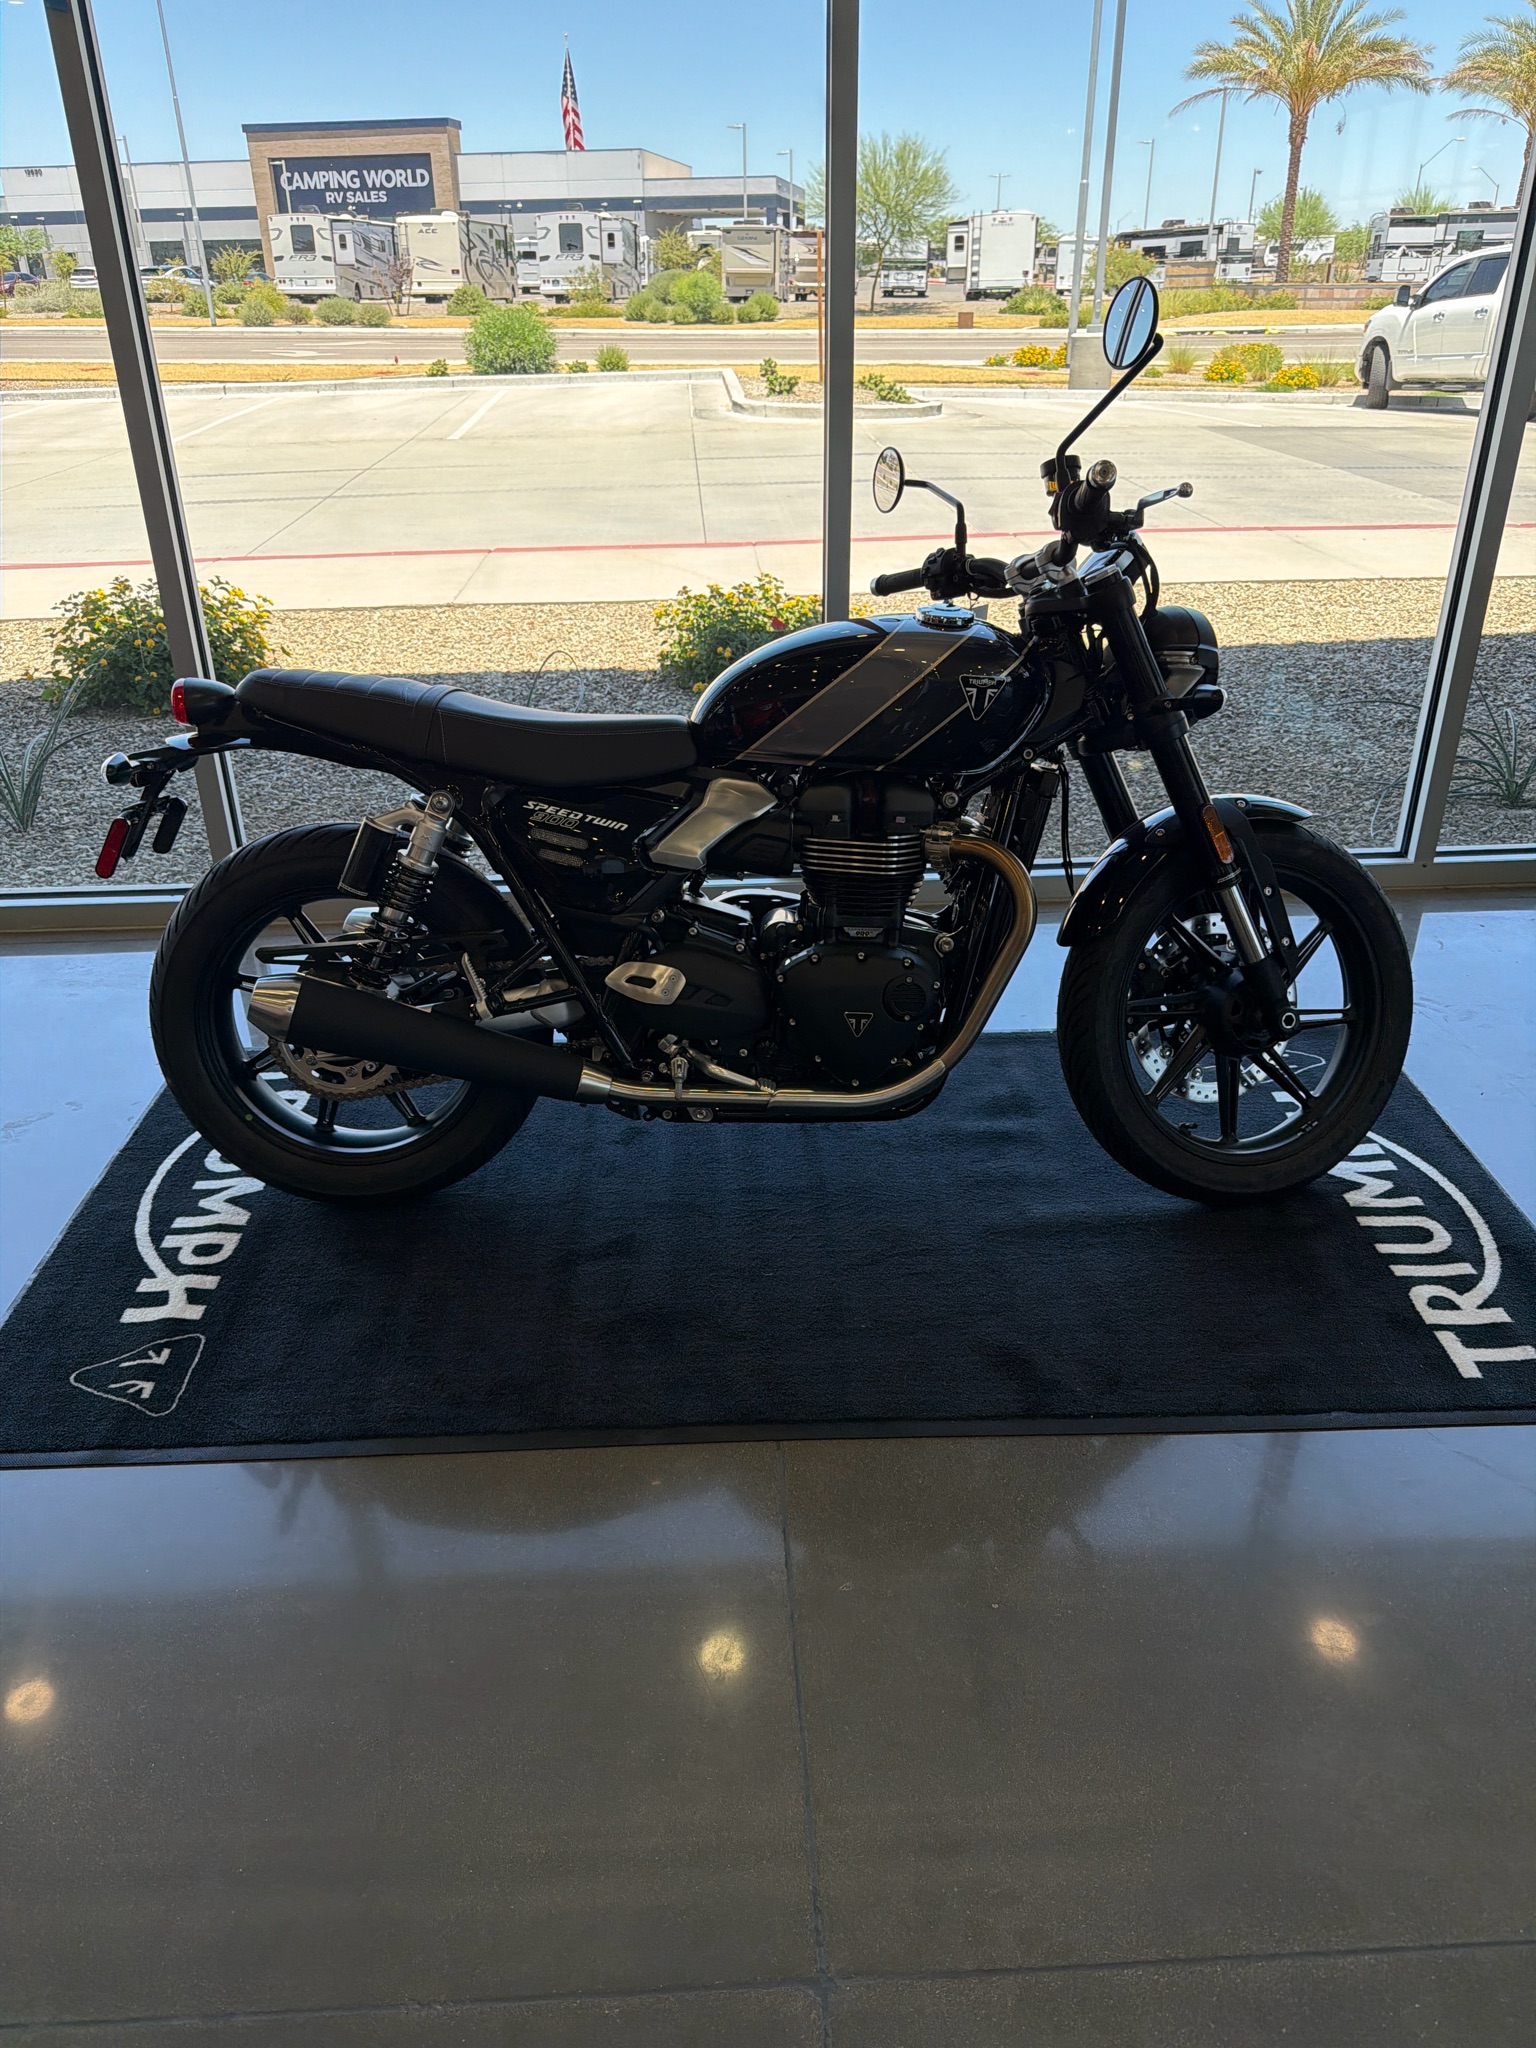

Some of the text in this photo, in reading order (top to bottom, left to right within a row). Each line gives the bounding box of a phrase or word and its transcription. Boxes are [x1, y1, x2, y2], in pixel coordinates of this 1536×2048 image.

[280, 168, 430, 191] CAMPING WORLD
[325, 190, 388, 204] RV SALES
[522, 800, 629, 832] SPEED TWIN
[529, 811, 580, 829] 900
